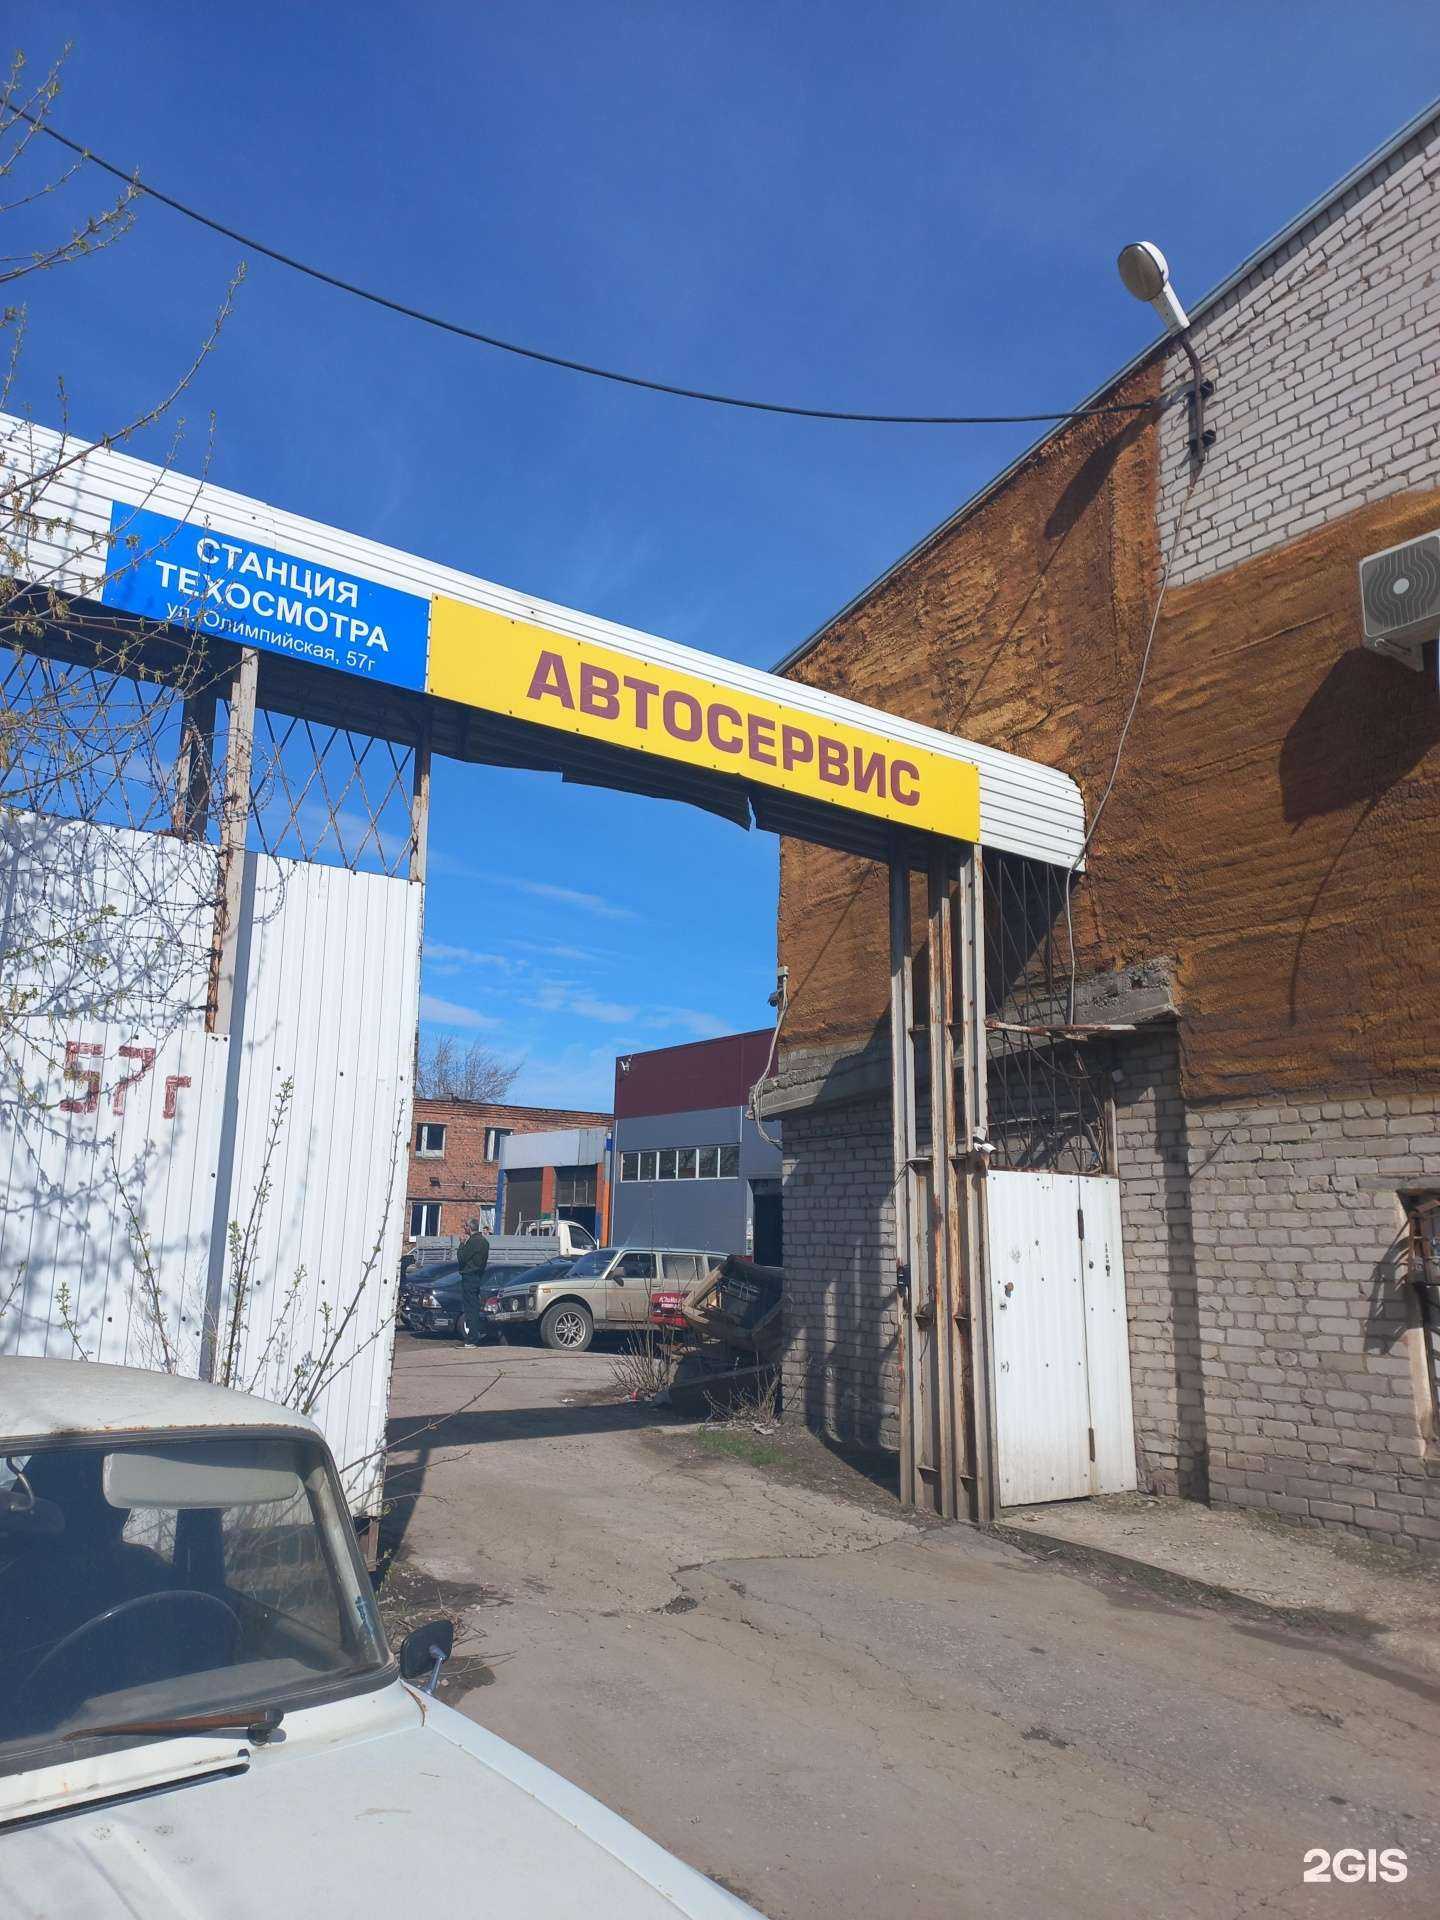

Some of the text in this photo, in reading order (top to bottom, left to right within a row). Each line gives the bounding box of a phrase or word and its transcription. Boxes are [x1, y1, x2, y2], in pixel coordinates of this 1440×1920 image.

[155, 560, 390, 652] ТЕХОСМОТРА
[196, 538, 359, 608] СТАНЦИЯ
[203, 610, 341, 665] Олимпийская,
[346, 651, 376, 672] 57г
[526, 650, 921, 807] АВТОСЕРВИС
